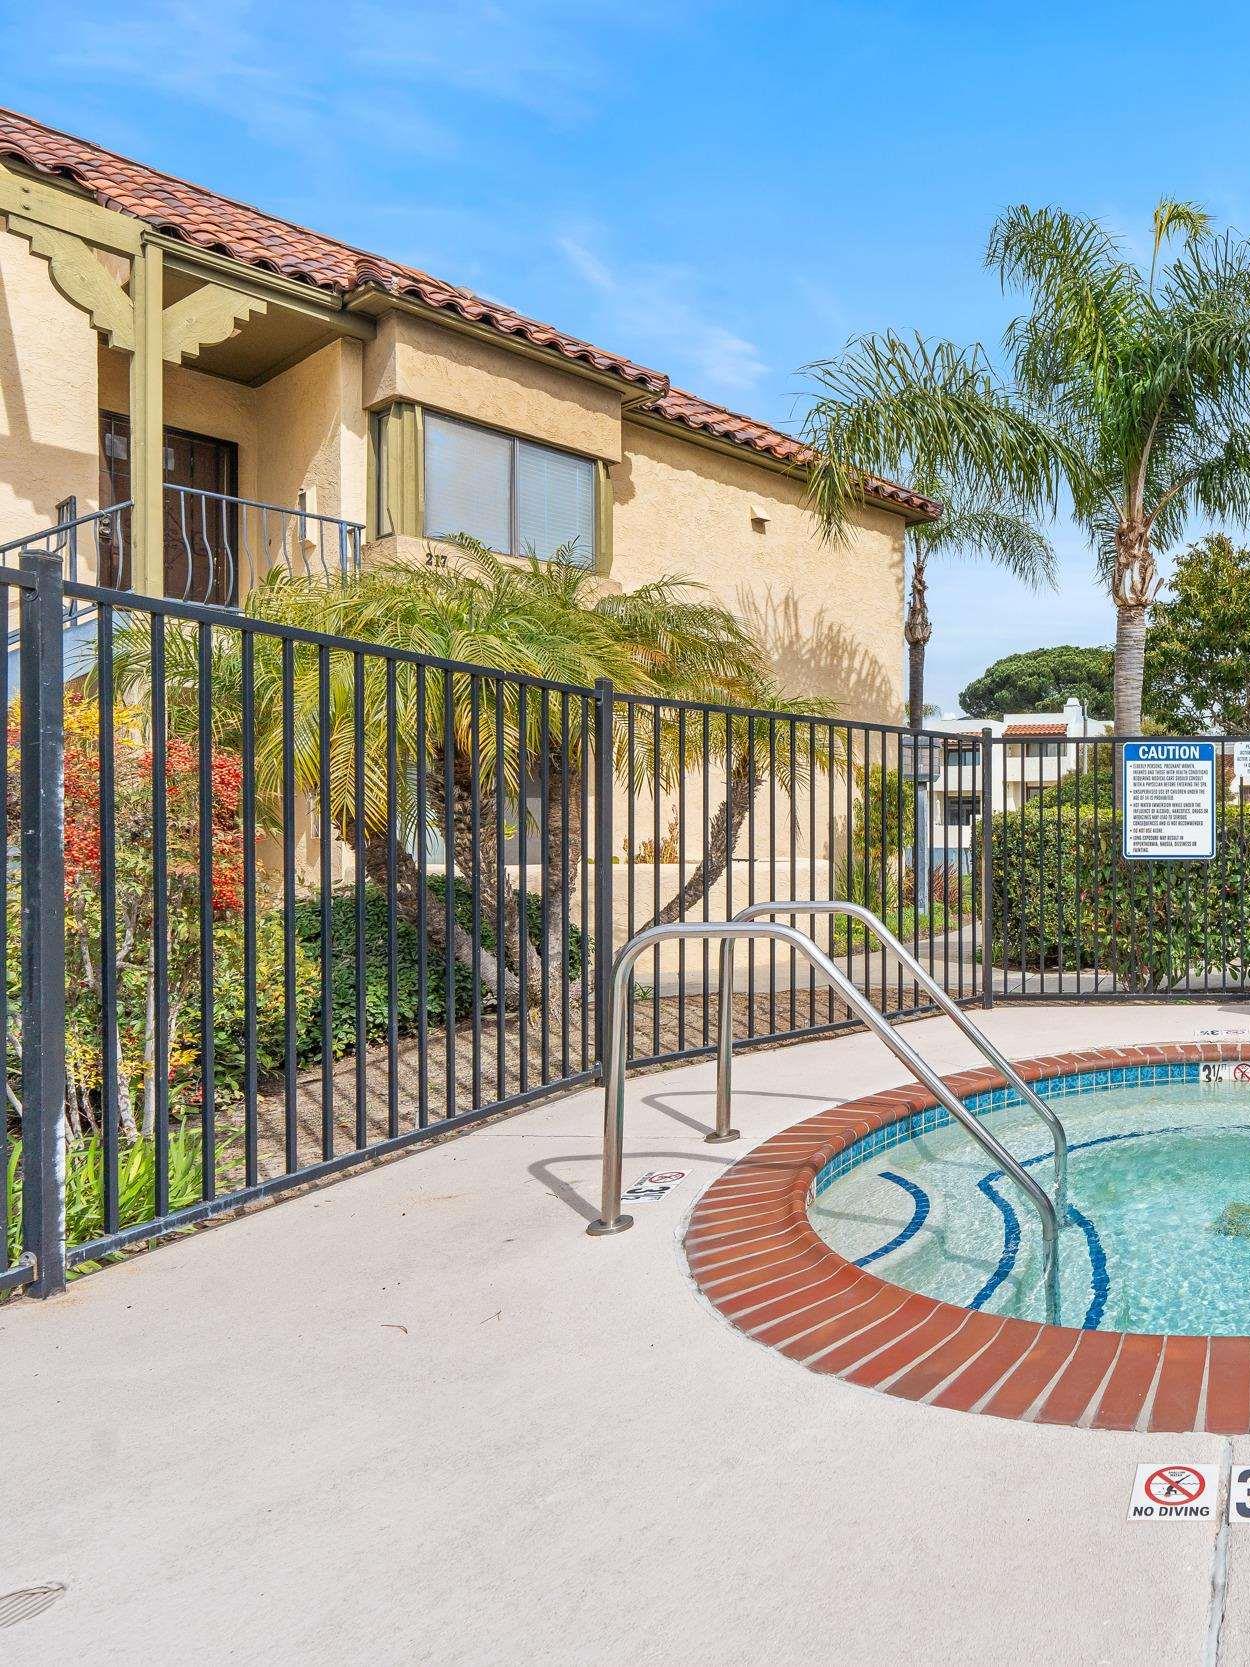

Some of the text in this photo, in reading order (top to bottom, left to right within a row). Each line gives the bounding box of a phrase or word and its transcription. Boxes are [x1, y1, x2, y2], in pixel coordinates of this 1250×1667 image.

[1139, 746, 1200, 759] CAUTION
[1133, 1506, 1211, 1517] NO DIVING
